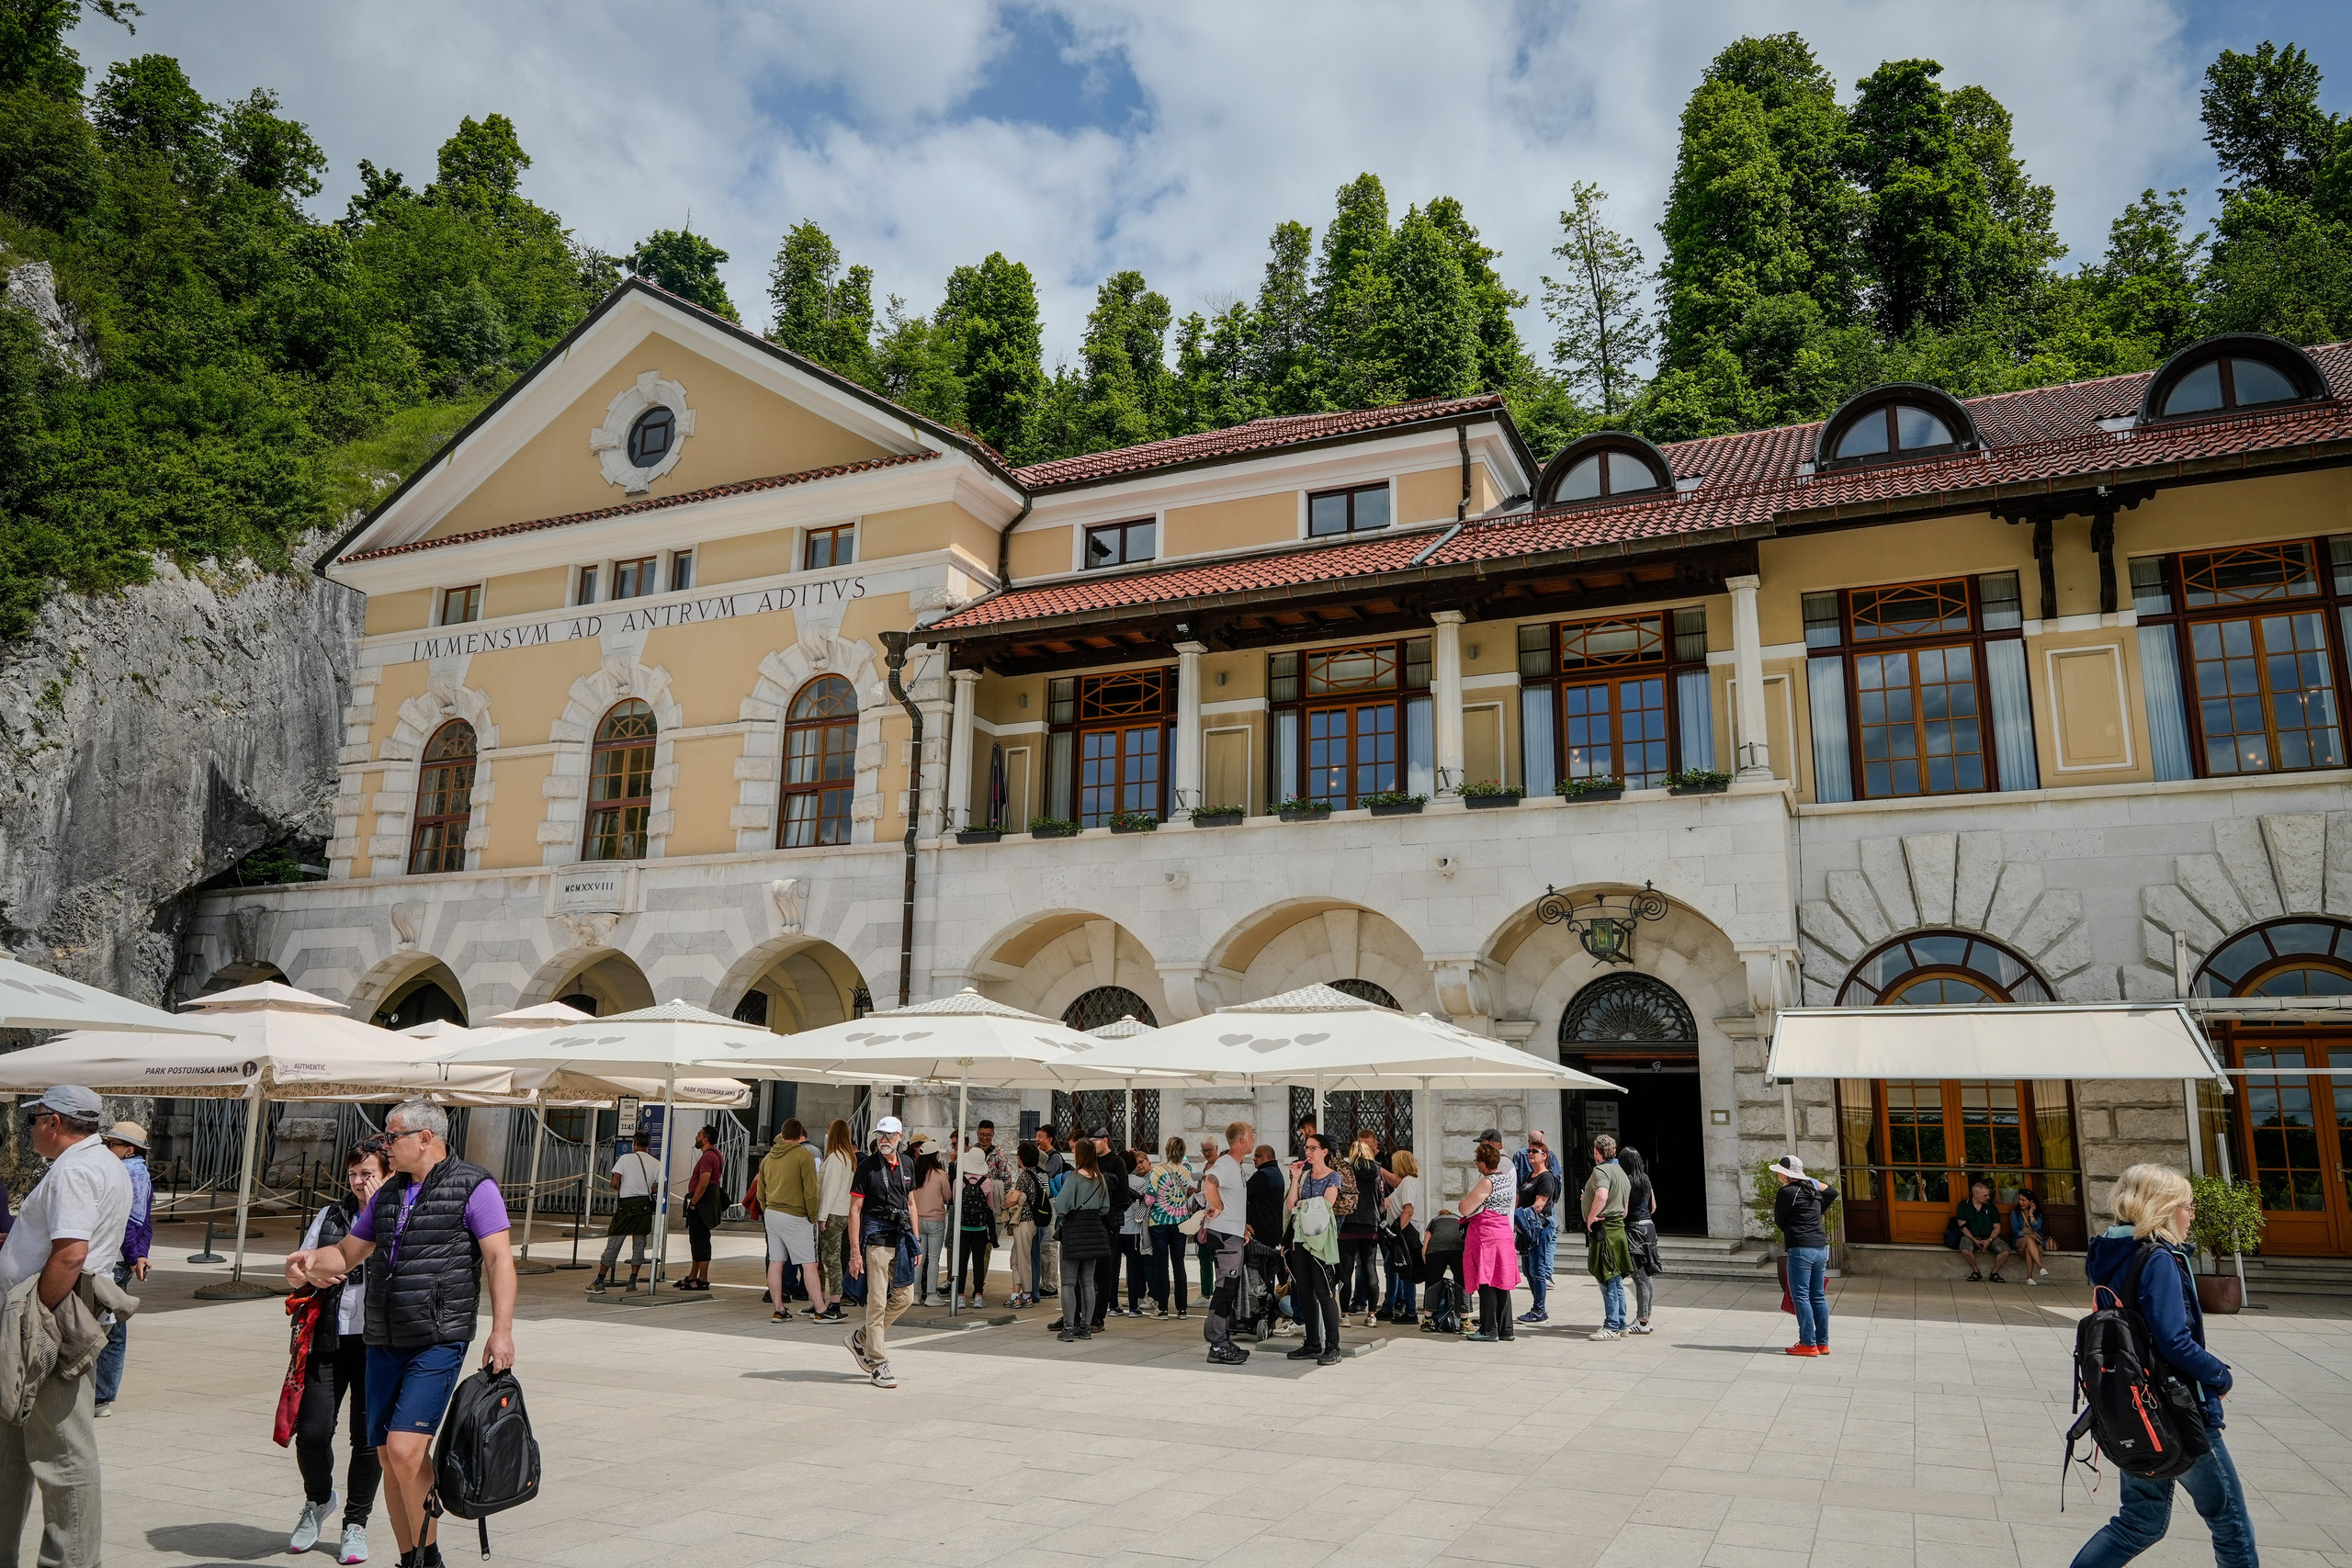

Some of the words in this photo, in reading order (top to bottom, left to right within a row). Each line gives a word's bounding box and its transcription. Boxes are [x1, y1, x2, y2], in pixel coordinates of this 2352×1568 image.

[413, 624, 550, 661] IMMENSVM
[568, 616, 603, 639] AD
[621, 596, 737, 633] ANTRVM
[757, 576, 866, 614] ADITVS
[565, 882, 614, 893] MCMXXVIII
[294, 1063, 326, 1071] AUTHENTIC
[621, 1122, 635, 1131] 11:45
